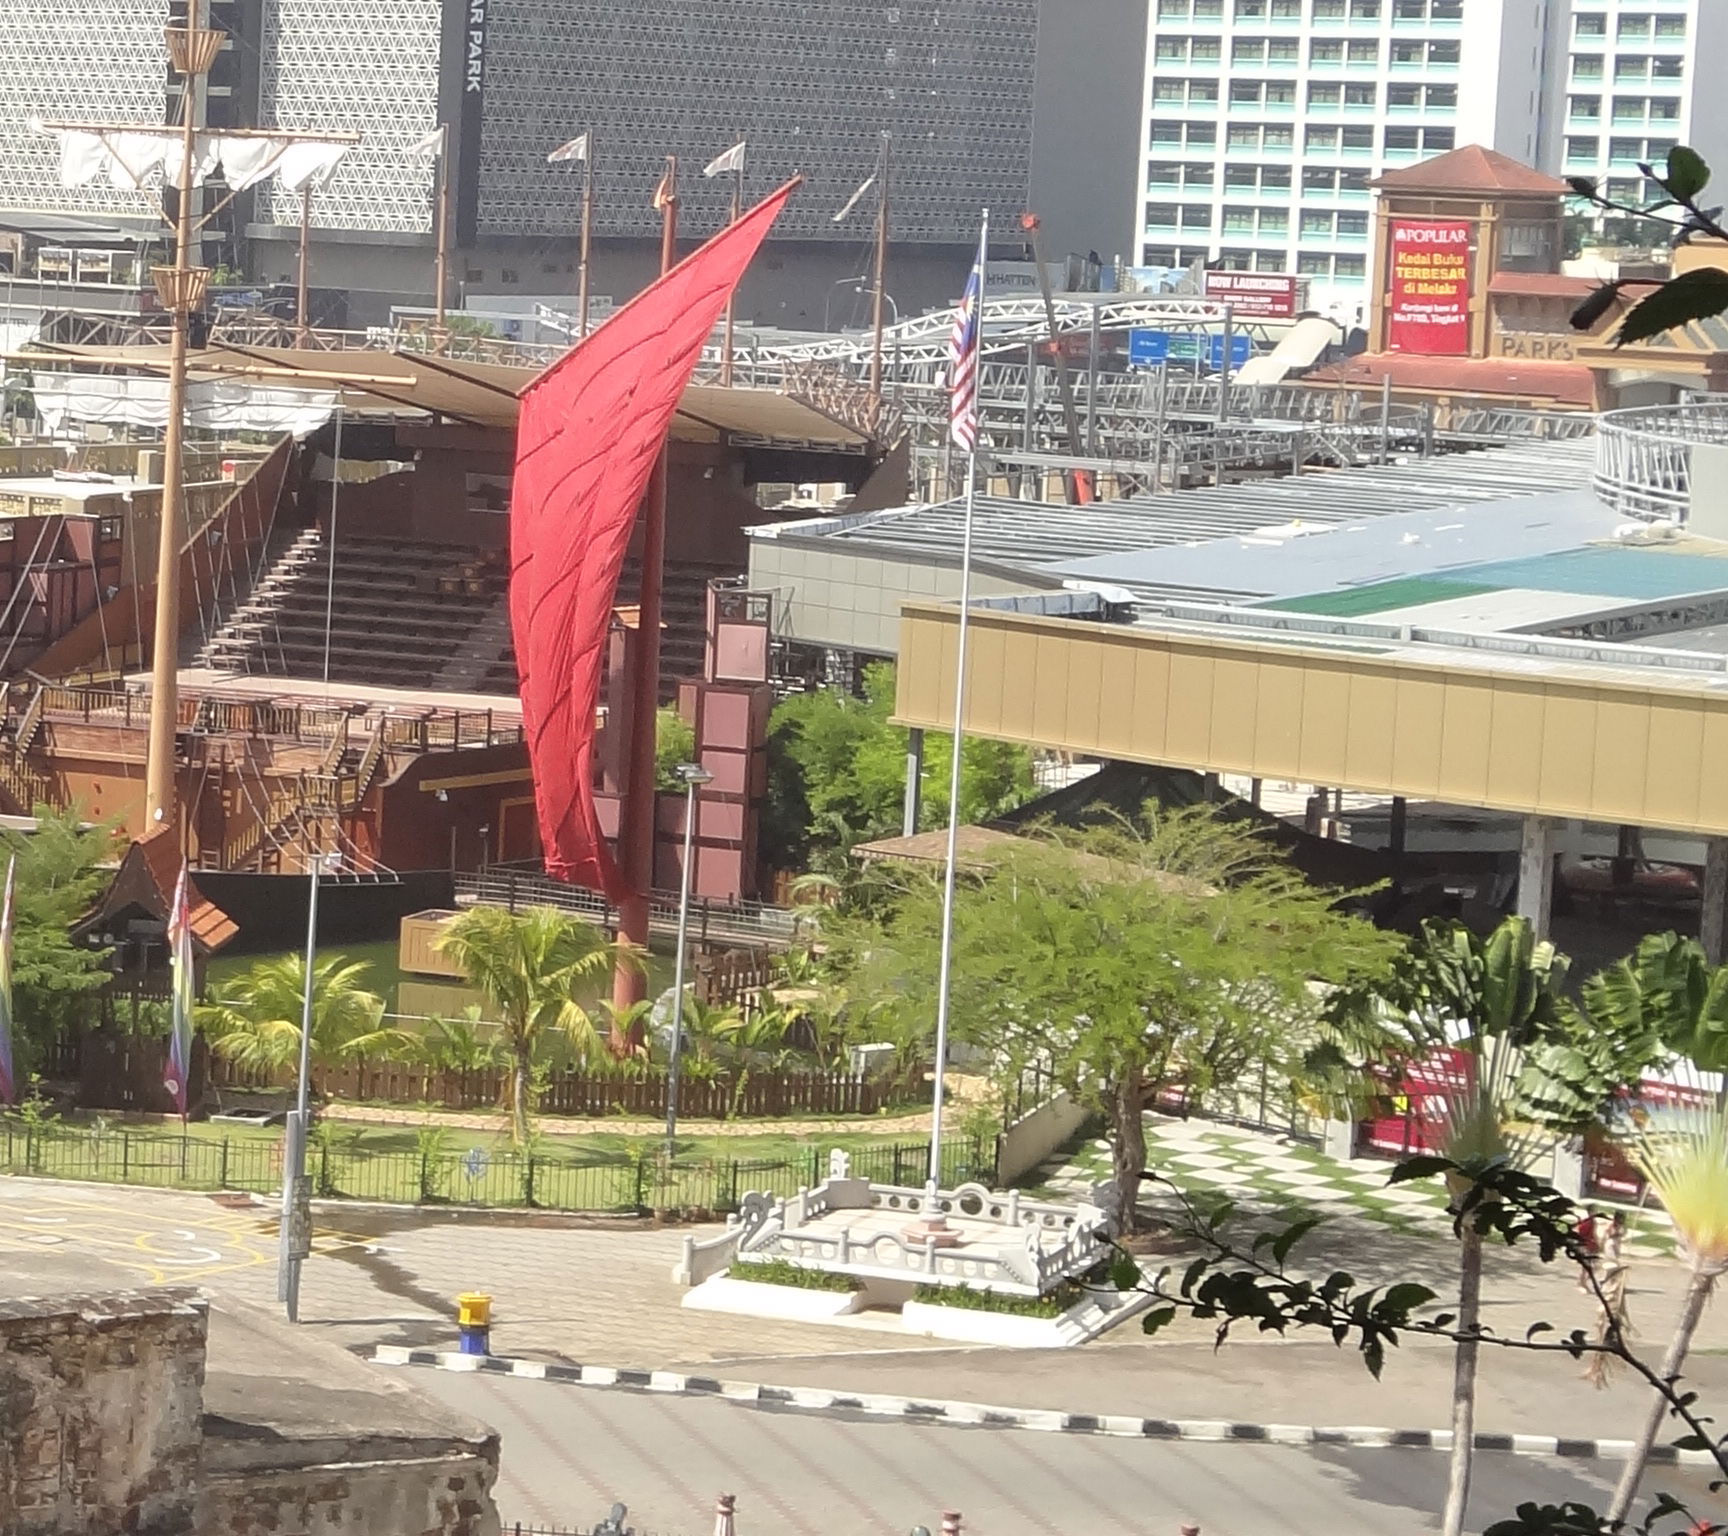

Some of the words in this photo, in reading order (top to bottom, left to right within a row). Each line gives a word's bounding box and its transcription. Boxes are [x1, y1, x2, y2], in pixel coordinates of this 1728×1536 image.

[466, 30, 484, 93] PARK
[1406, 228, 1468, 243] POPULAR
[1395, 266, 1467, 280] TERBESAR
